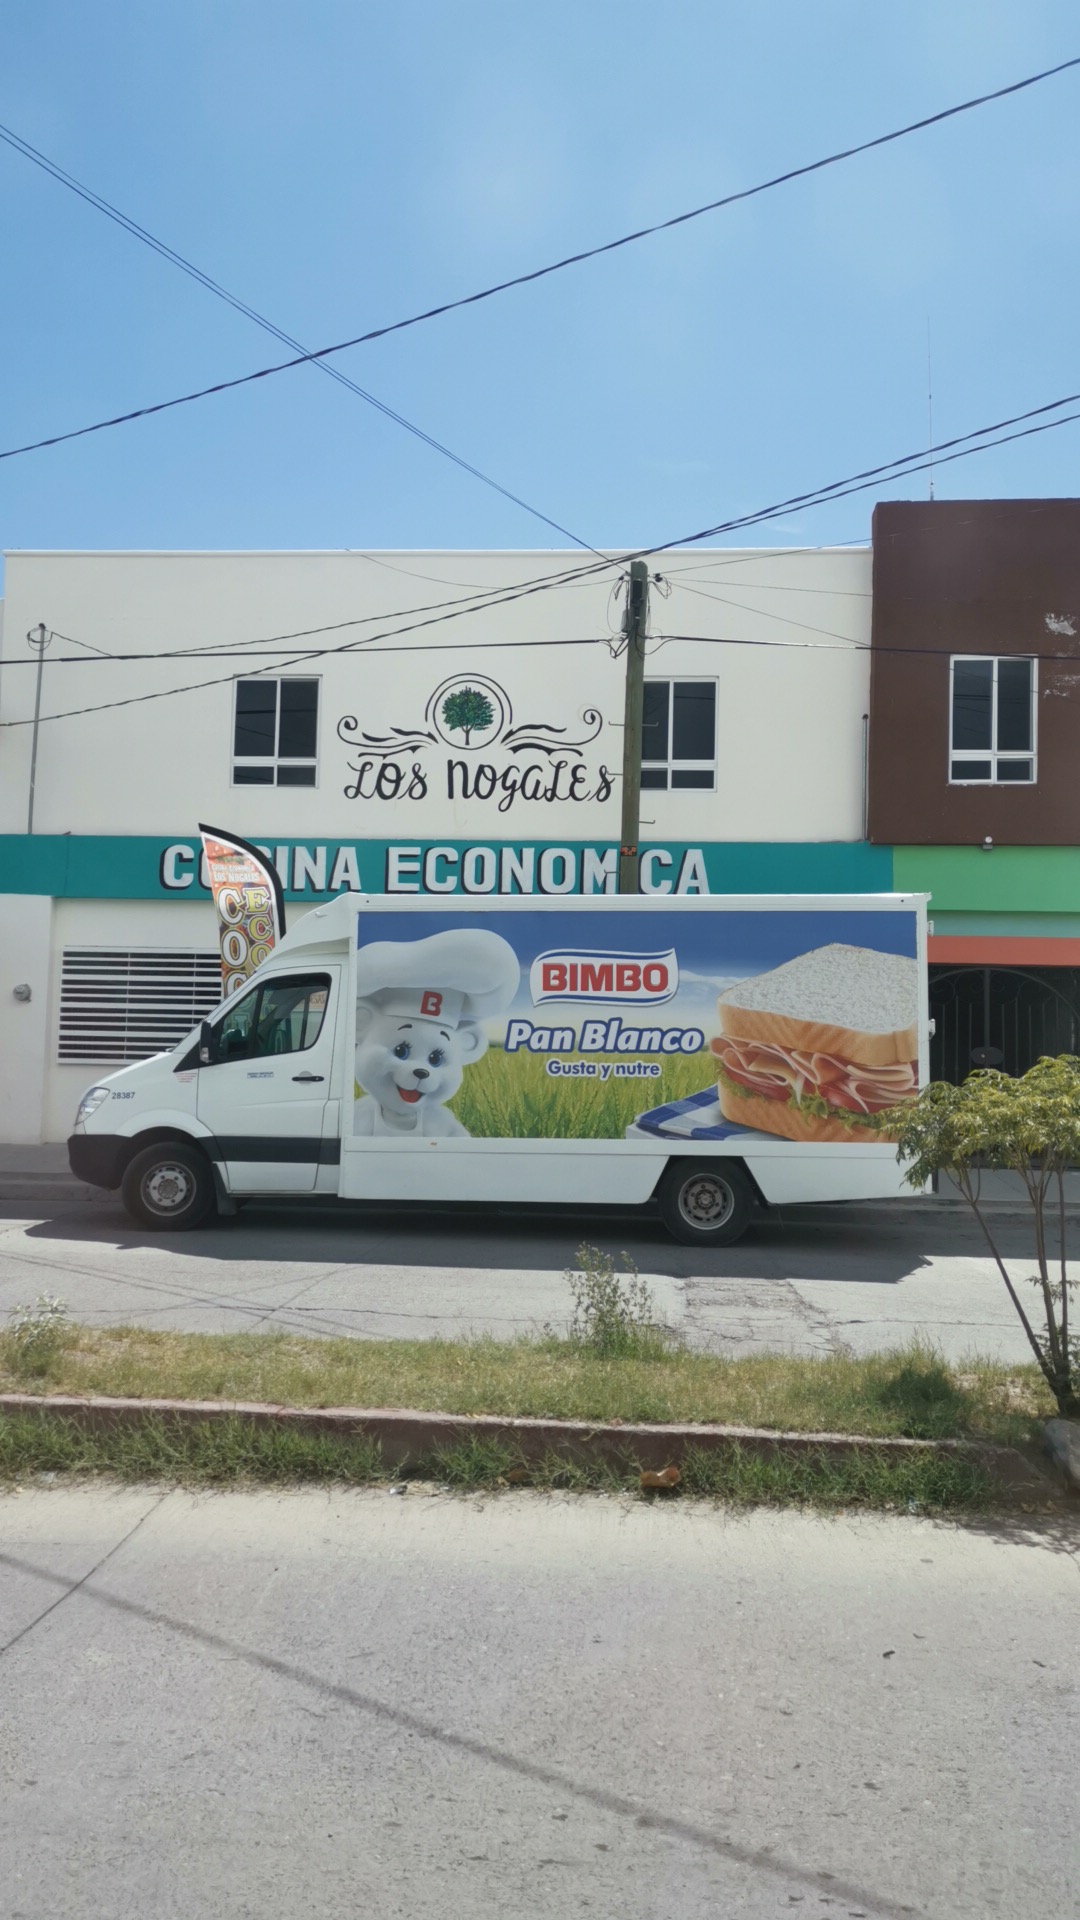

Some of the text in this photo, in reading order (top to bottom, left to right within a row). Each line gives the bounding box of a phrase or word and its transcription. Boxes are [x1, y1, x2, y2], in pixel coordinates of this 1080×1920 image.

[159, 843, 711, 896] CINA ECONOMCA
[542, 963, 669, 992] BIMBO
[505, 1017, 705, 1054] Pan Blanco
[548, 1060, 661, 1079] Gusta y nutre
[111, 1091, 136, 1100] 28387
